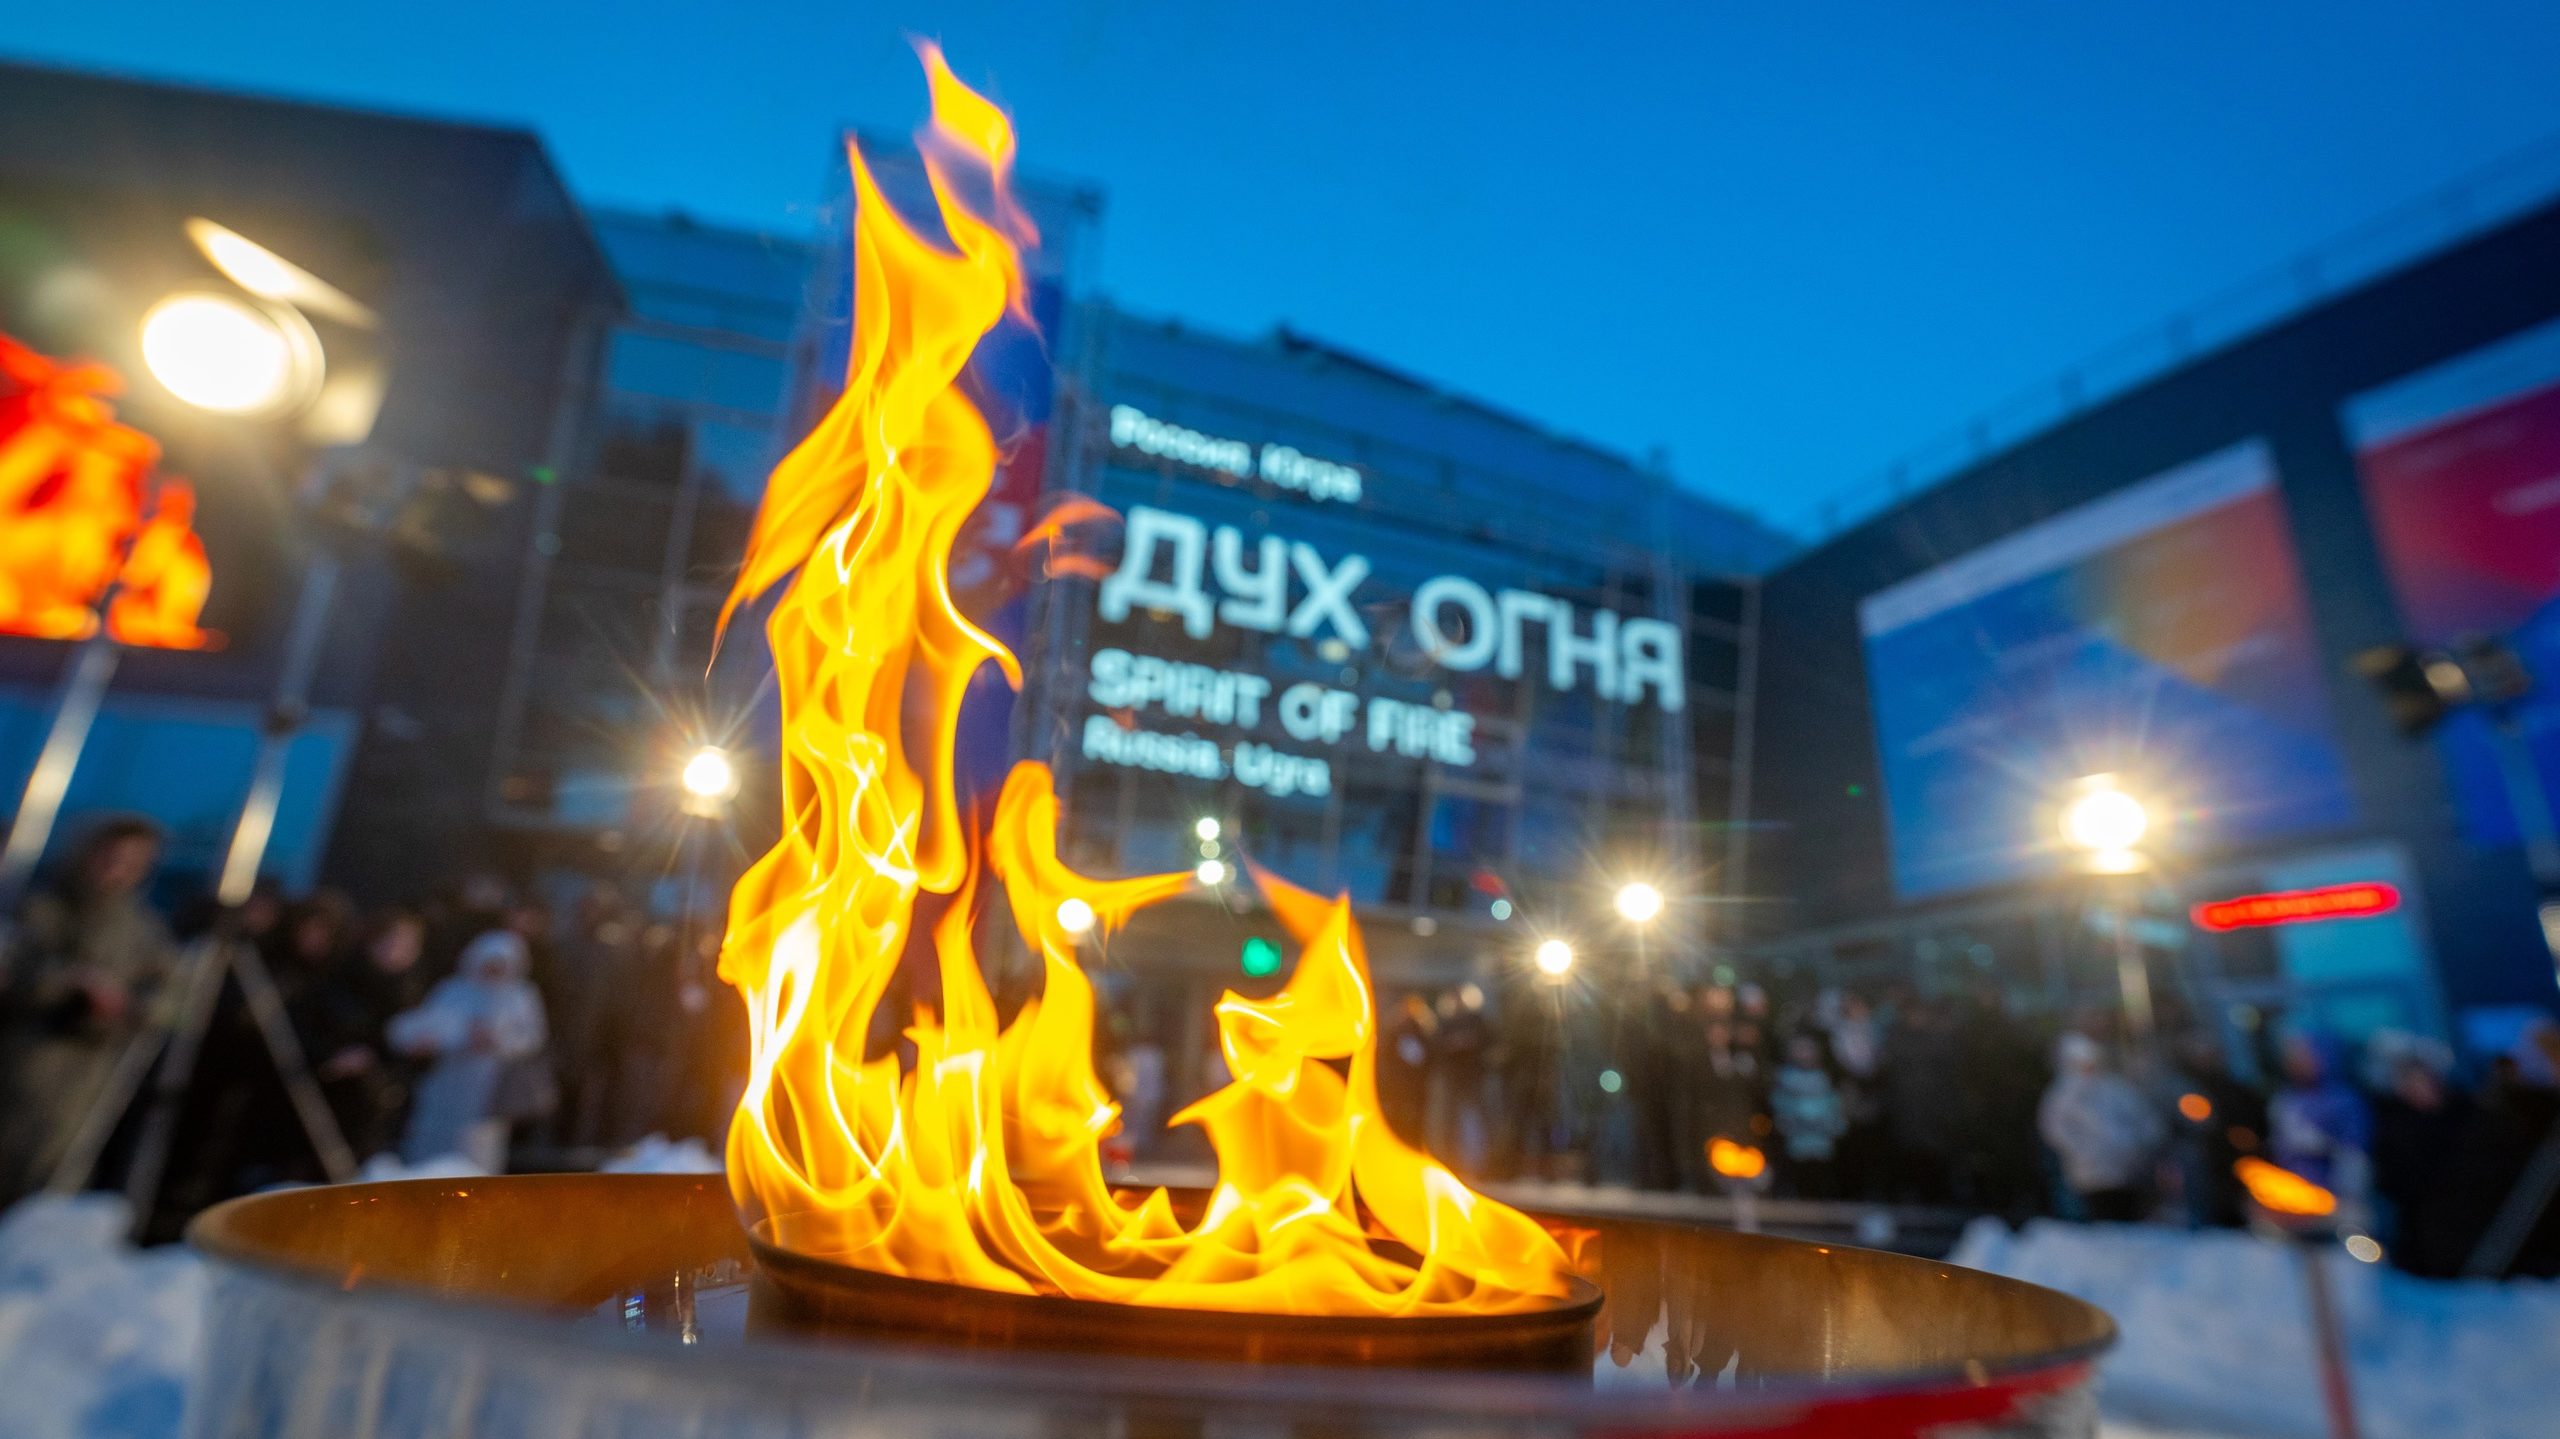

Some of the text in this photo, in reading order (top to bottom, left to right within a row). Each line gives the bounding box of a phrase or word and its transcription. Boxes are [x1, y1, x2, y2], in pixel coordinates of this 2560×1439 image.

[1101, 506, 1371, 650] ДУХ
[1411, 575, 1685, 711] ОГНЯ
[1088, 648, 1476, 766] SPIRIT OF FIRE
[1234, 741, 1331, 797] Ugra
